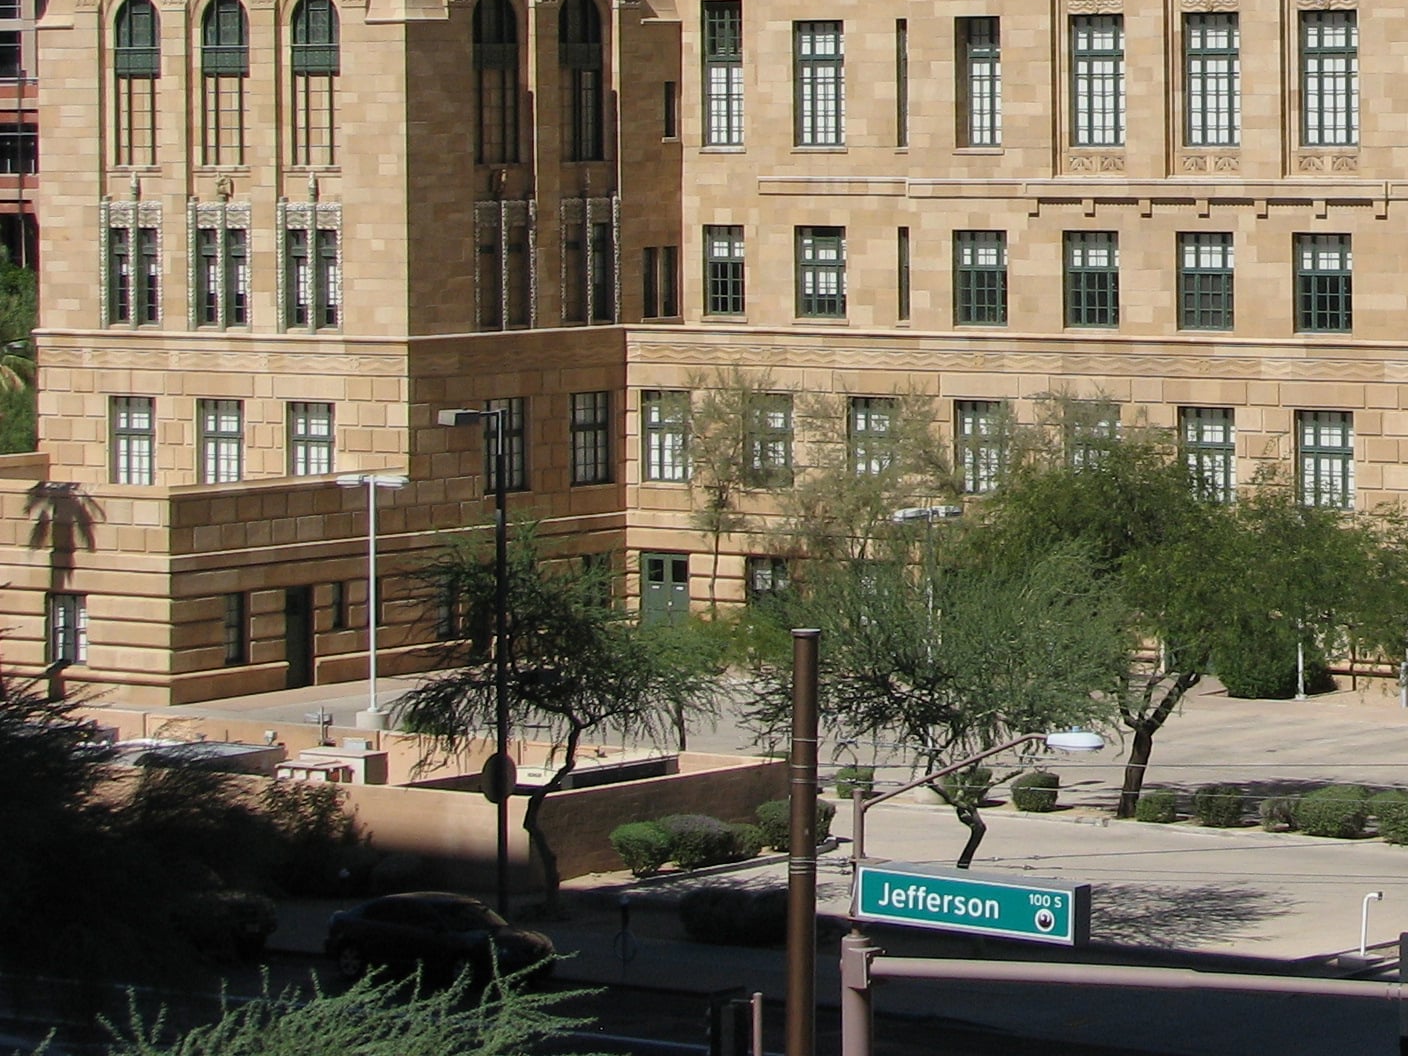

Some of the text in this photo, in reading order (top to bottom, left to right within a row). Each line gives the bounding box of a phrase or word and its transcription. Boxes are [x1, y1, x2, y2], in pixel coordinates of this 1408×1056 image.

[878, 882, 999, 919] Jefferson
[1029, 894, 1062, 908] 100 S
